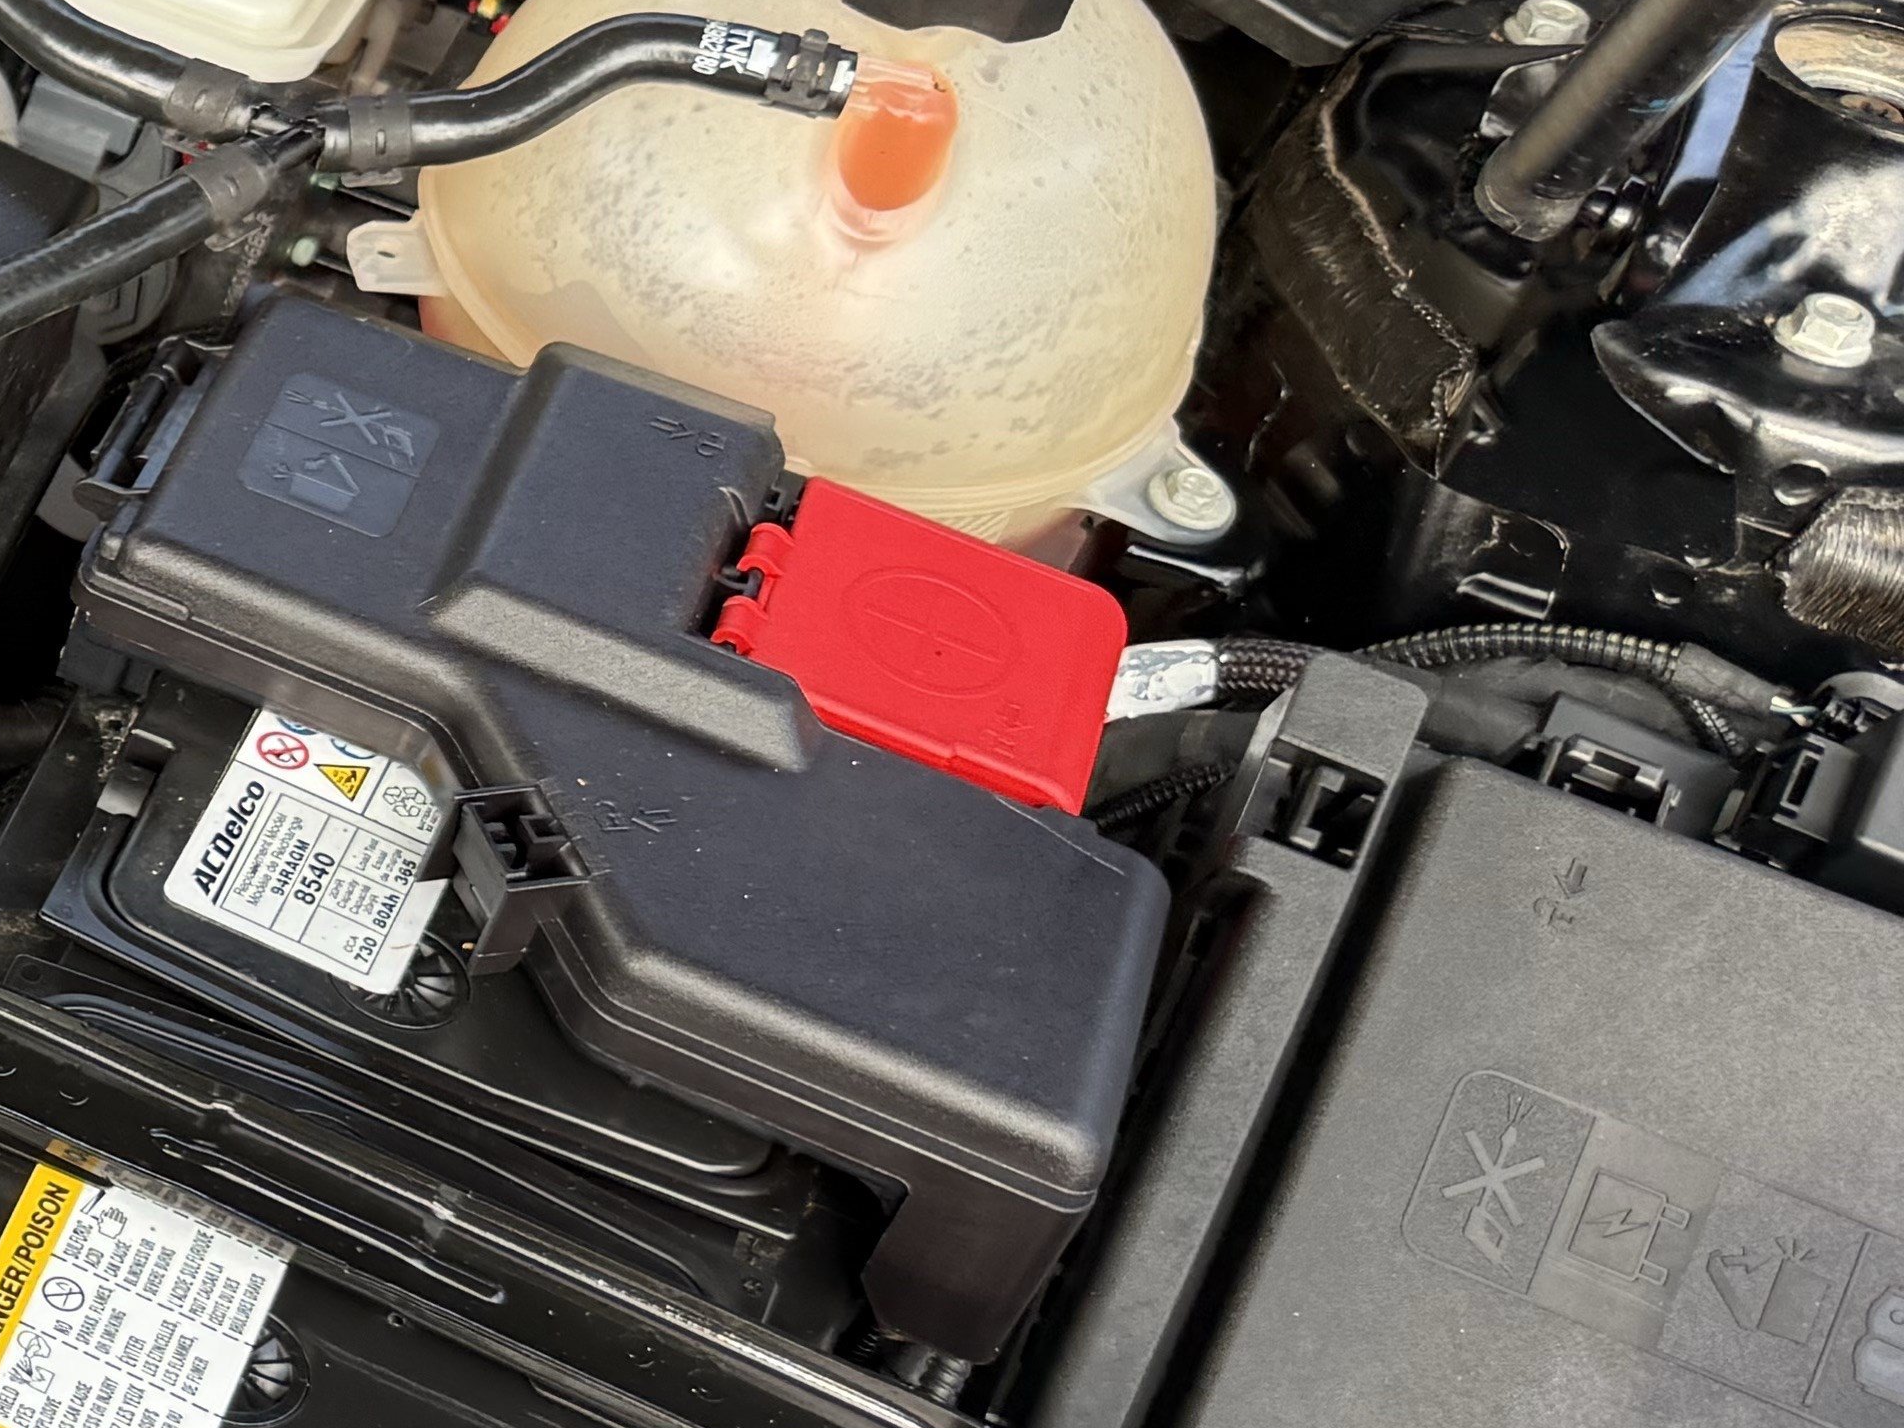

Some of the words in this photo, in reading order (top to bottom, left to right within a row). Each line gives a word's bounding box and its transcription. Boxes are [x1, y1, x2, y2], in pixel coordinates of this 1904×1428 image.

[719, 29, 754, 74] TNK
[194, 781, 264, 894] ACDelco
[263, 811, 287, 840] Model
[265, 859, 279, 873] de
[293, 851, 335, 905] 8540
[393, 857, 417, 886] 365
[371, 893, 400, 929] 80Ah
[342, 934, 359, 953] CCA
[353, 935, 378, 963] 730
[208, 1261, 224, 1273] LA
[115, 1334, 146, 1368] ÉVITER
[141, 1359, 160, 1377] LES
[160, 1368, 180, 1386] LES
[69, 1380, 93, 1408] CAUSE
[122, 1382, 145, 1408] YEUX
[180, 1381, 199, 1396] DE
[12, 1402, 36, 1428] EYES
[62, 1404, 81, 1423] CAN
[113, 1405, 136, 1426] LES
